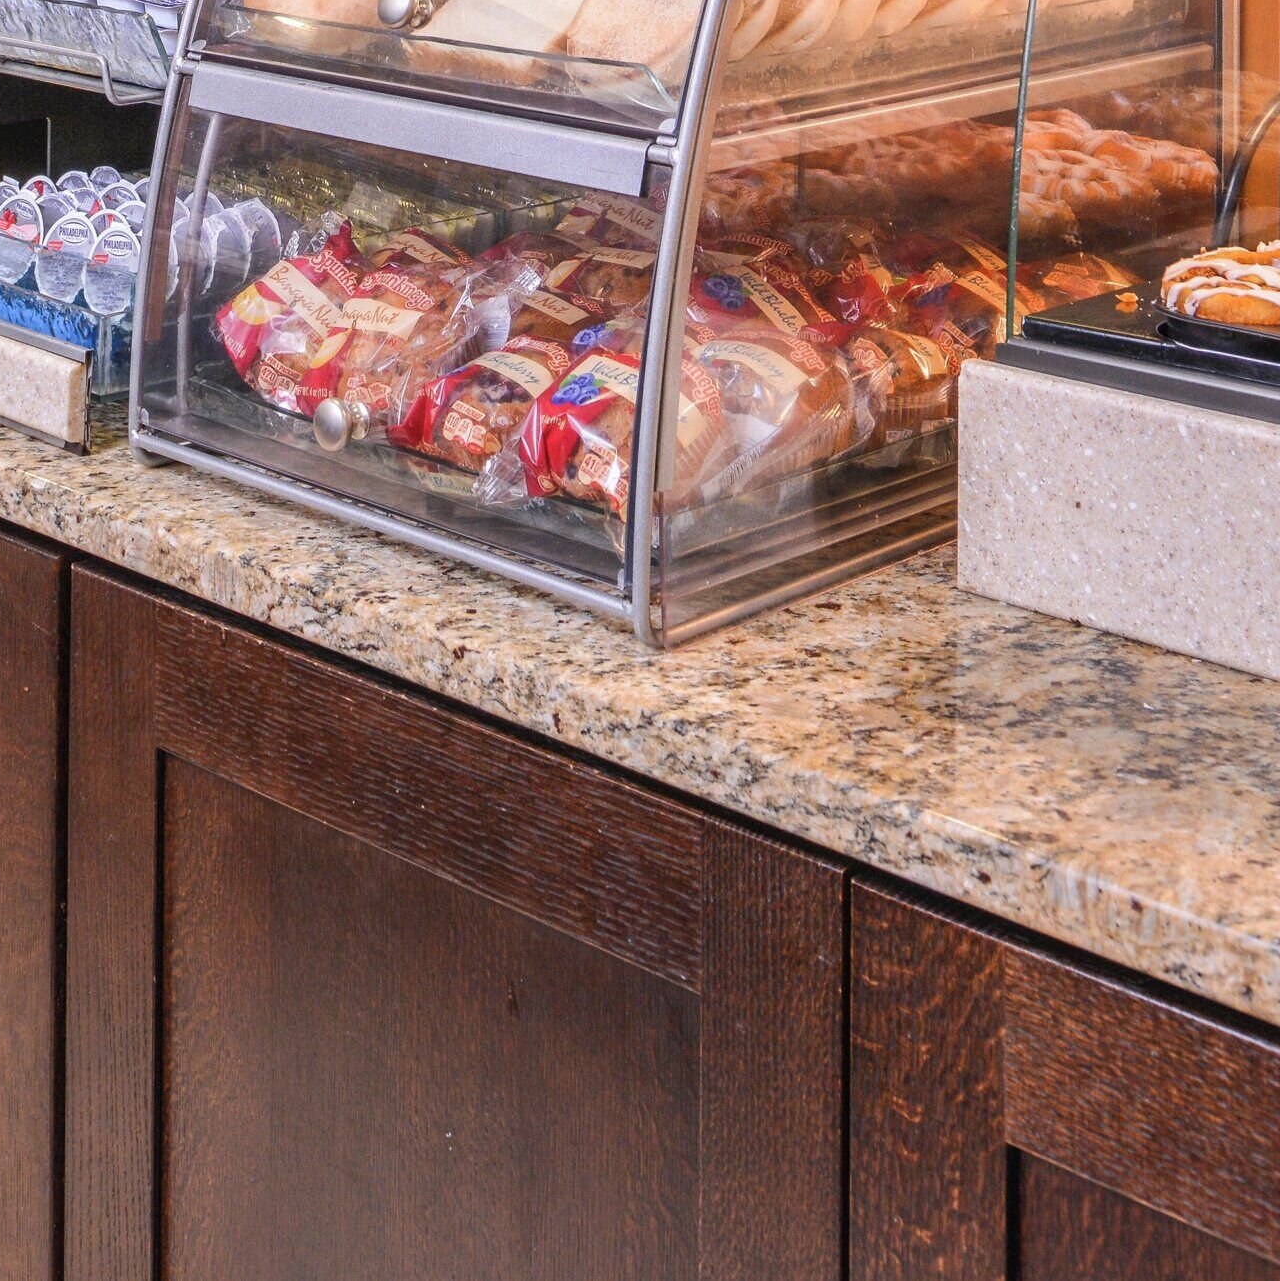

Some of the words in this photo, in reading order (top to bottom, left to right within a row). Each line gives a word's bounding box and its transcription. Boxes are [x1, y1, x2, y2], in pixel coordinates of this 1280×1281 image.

[624, 206, 655, 230] Nut
[59, 226, 89, 239] PHILADELPHIA
[104, 239, 133, 251] PHILADELPHIA
[269, 266, 317, 313] Banana
[739, 271, 768, 298] Wild
[537, 293, 569, 314] Nut
[371, 305, 400, 325] Nut
[261, 367, 276, 382] 470
[590, 360, 622, 383] Wild
[446, 414, 460, 428] 410
[584, 456, 600, 473] 410
